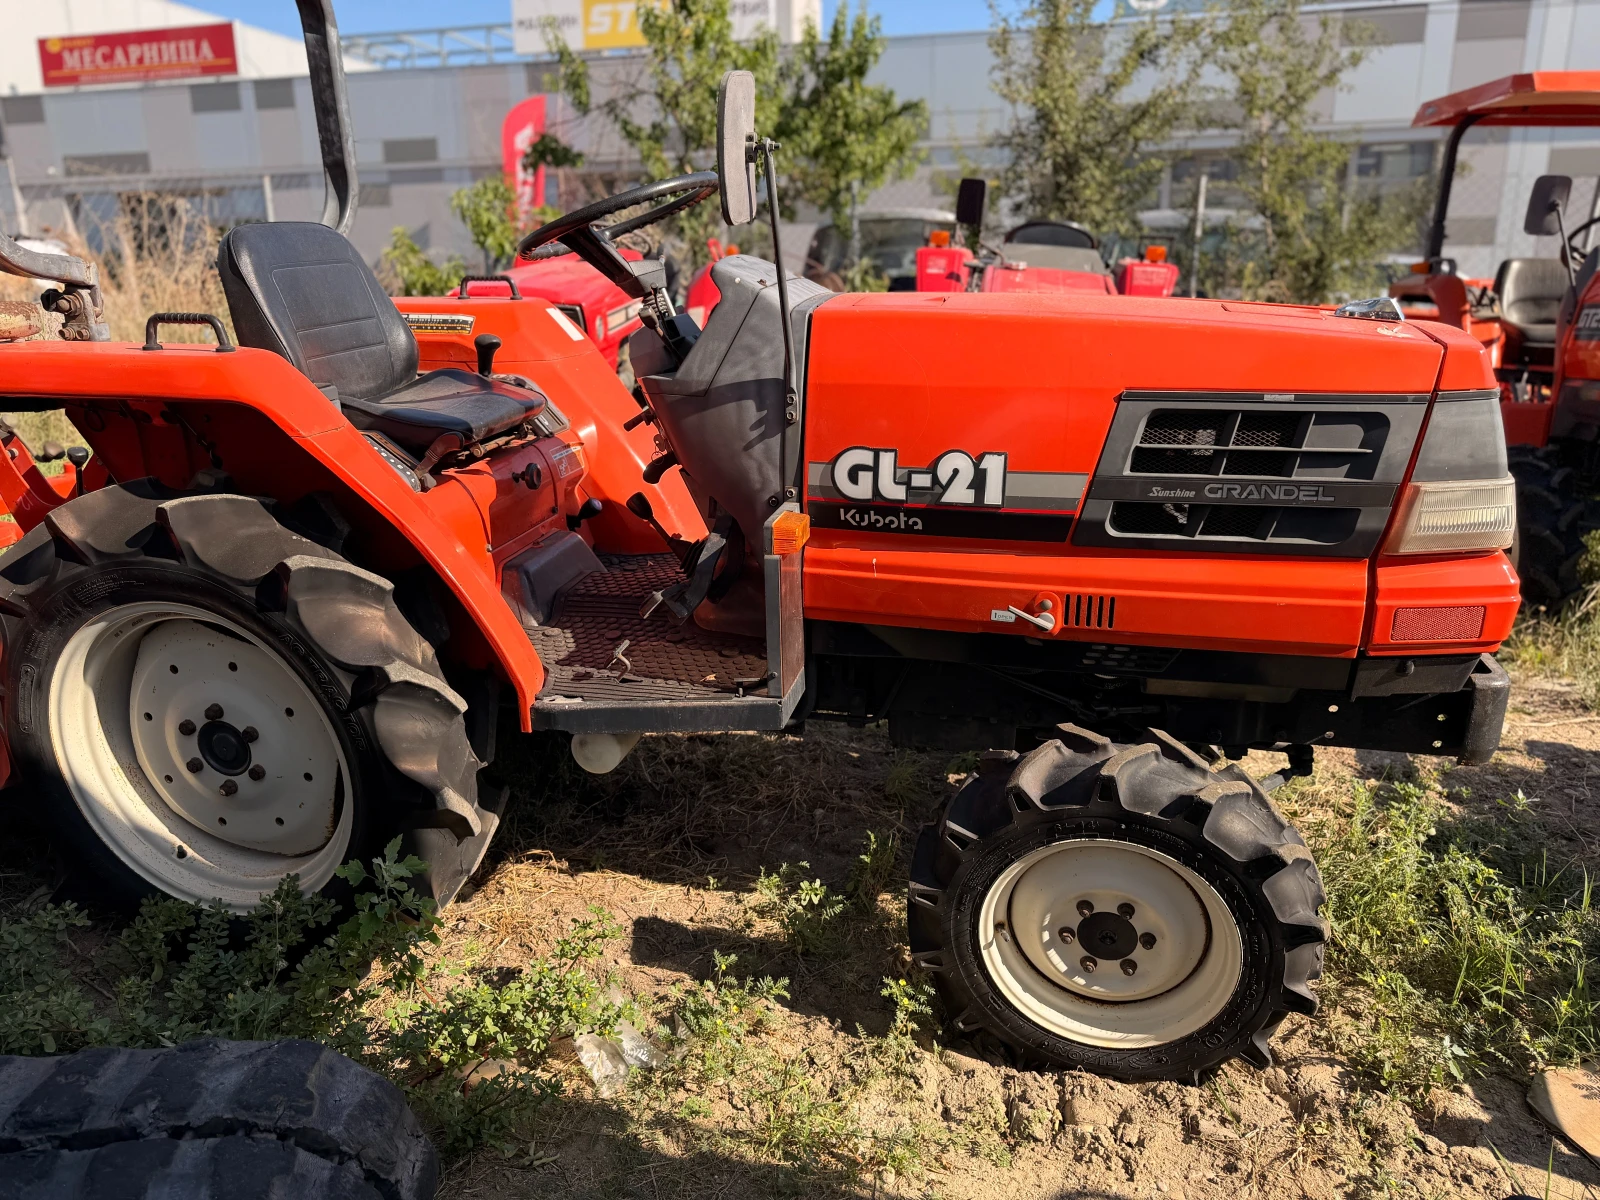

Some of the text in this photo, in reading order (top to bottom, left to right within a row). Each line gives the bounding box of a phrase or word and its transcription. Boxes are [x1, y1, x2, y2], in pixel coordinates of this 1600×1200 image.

[62, 38, 215, 72] МЕСАРНИЦА
[832, 446, 1007, 507] GL-21
[1148, 483, 1335, 502] Sunshine GRANDEL
[839, 508, 923, 530] Kubota
